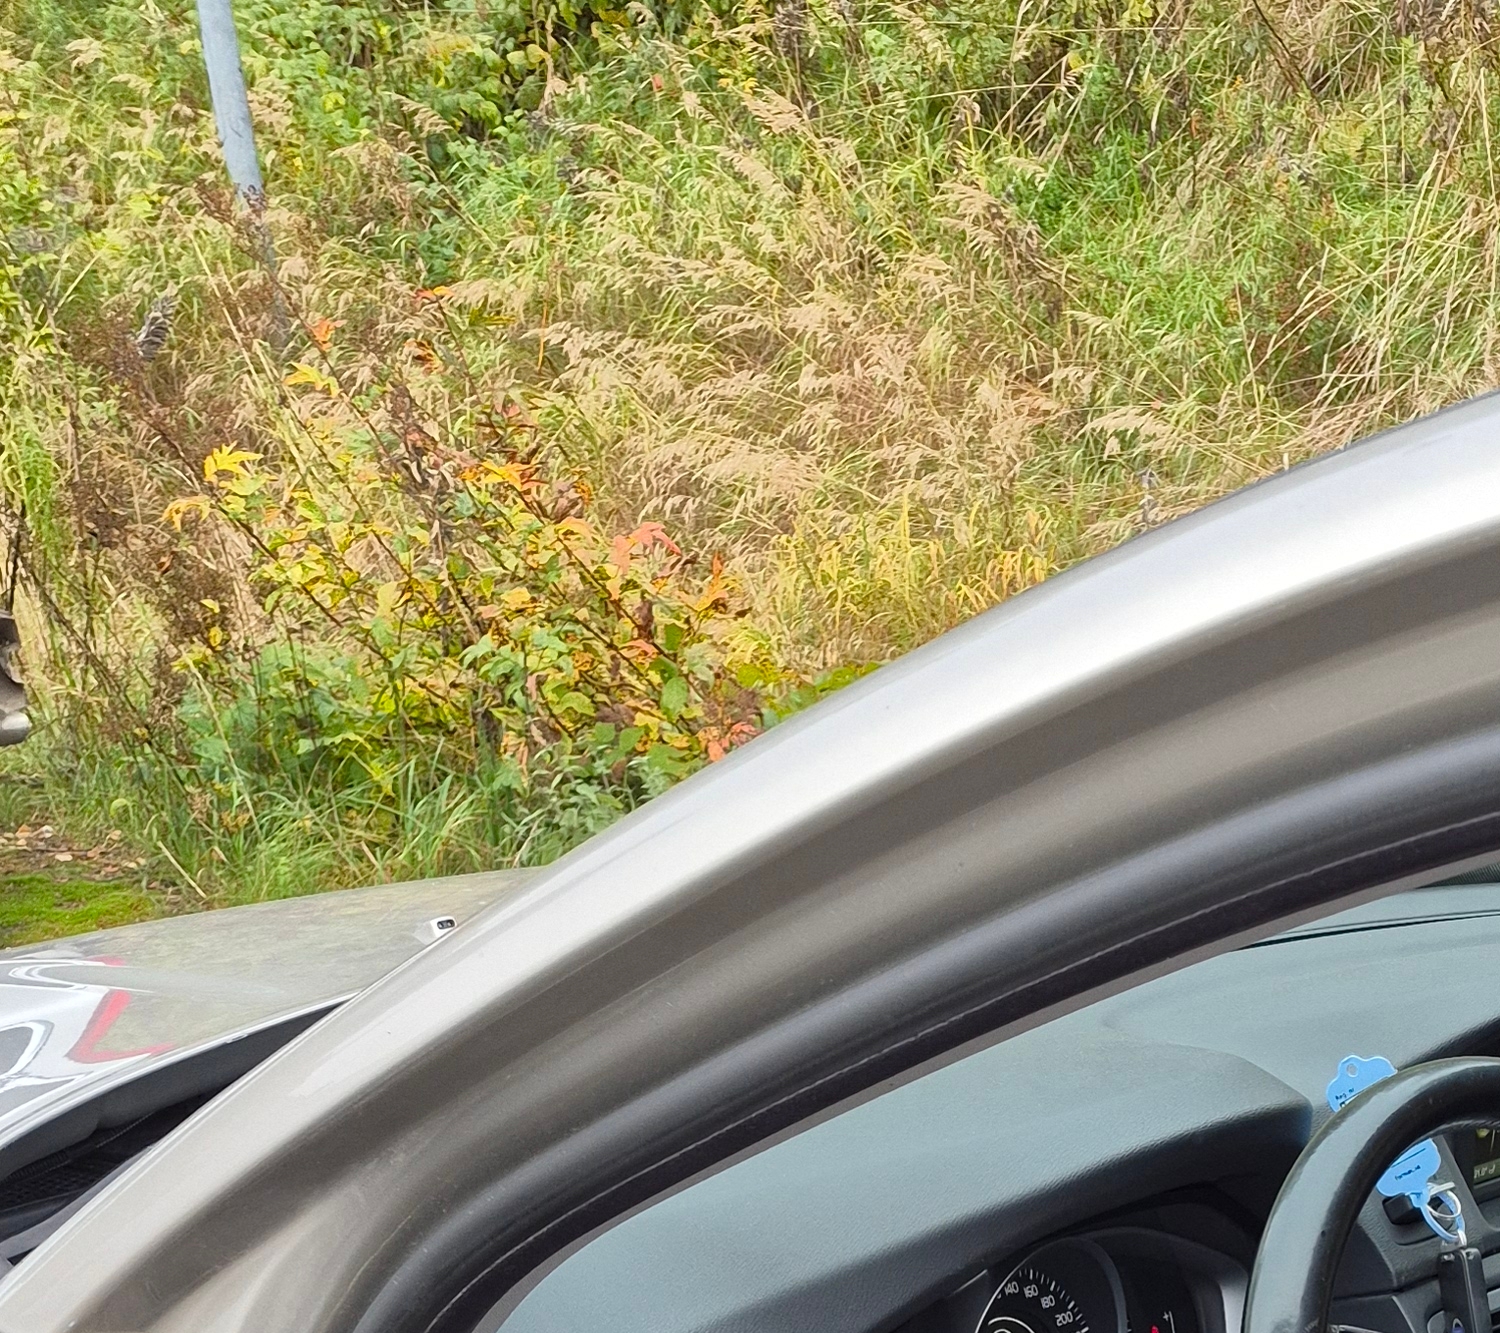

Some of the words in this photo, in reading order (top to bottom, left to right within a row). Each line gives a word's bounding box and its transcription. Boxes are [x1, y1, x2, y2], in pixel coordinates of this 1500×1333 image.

[1004, 1281, 1019, 1296] 140
[1023, 1284, 1039, 1298] 160
[1040, 1295, 1055, 1309] 180
[1055, 1311, 1073, 1327] 200
